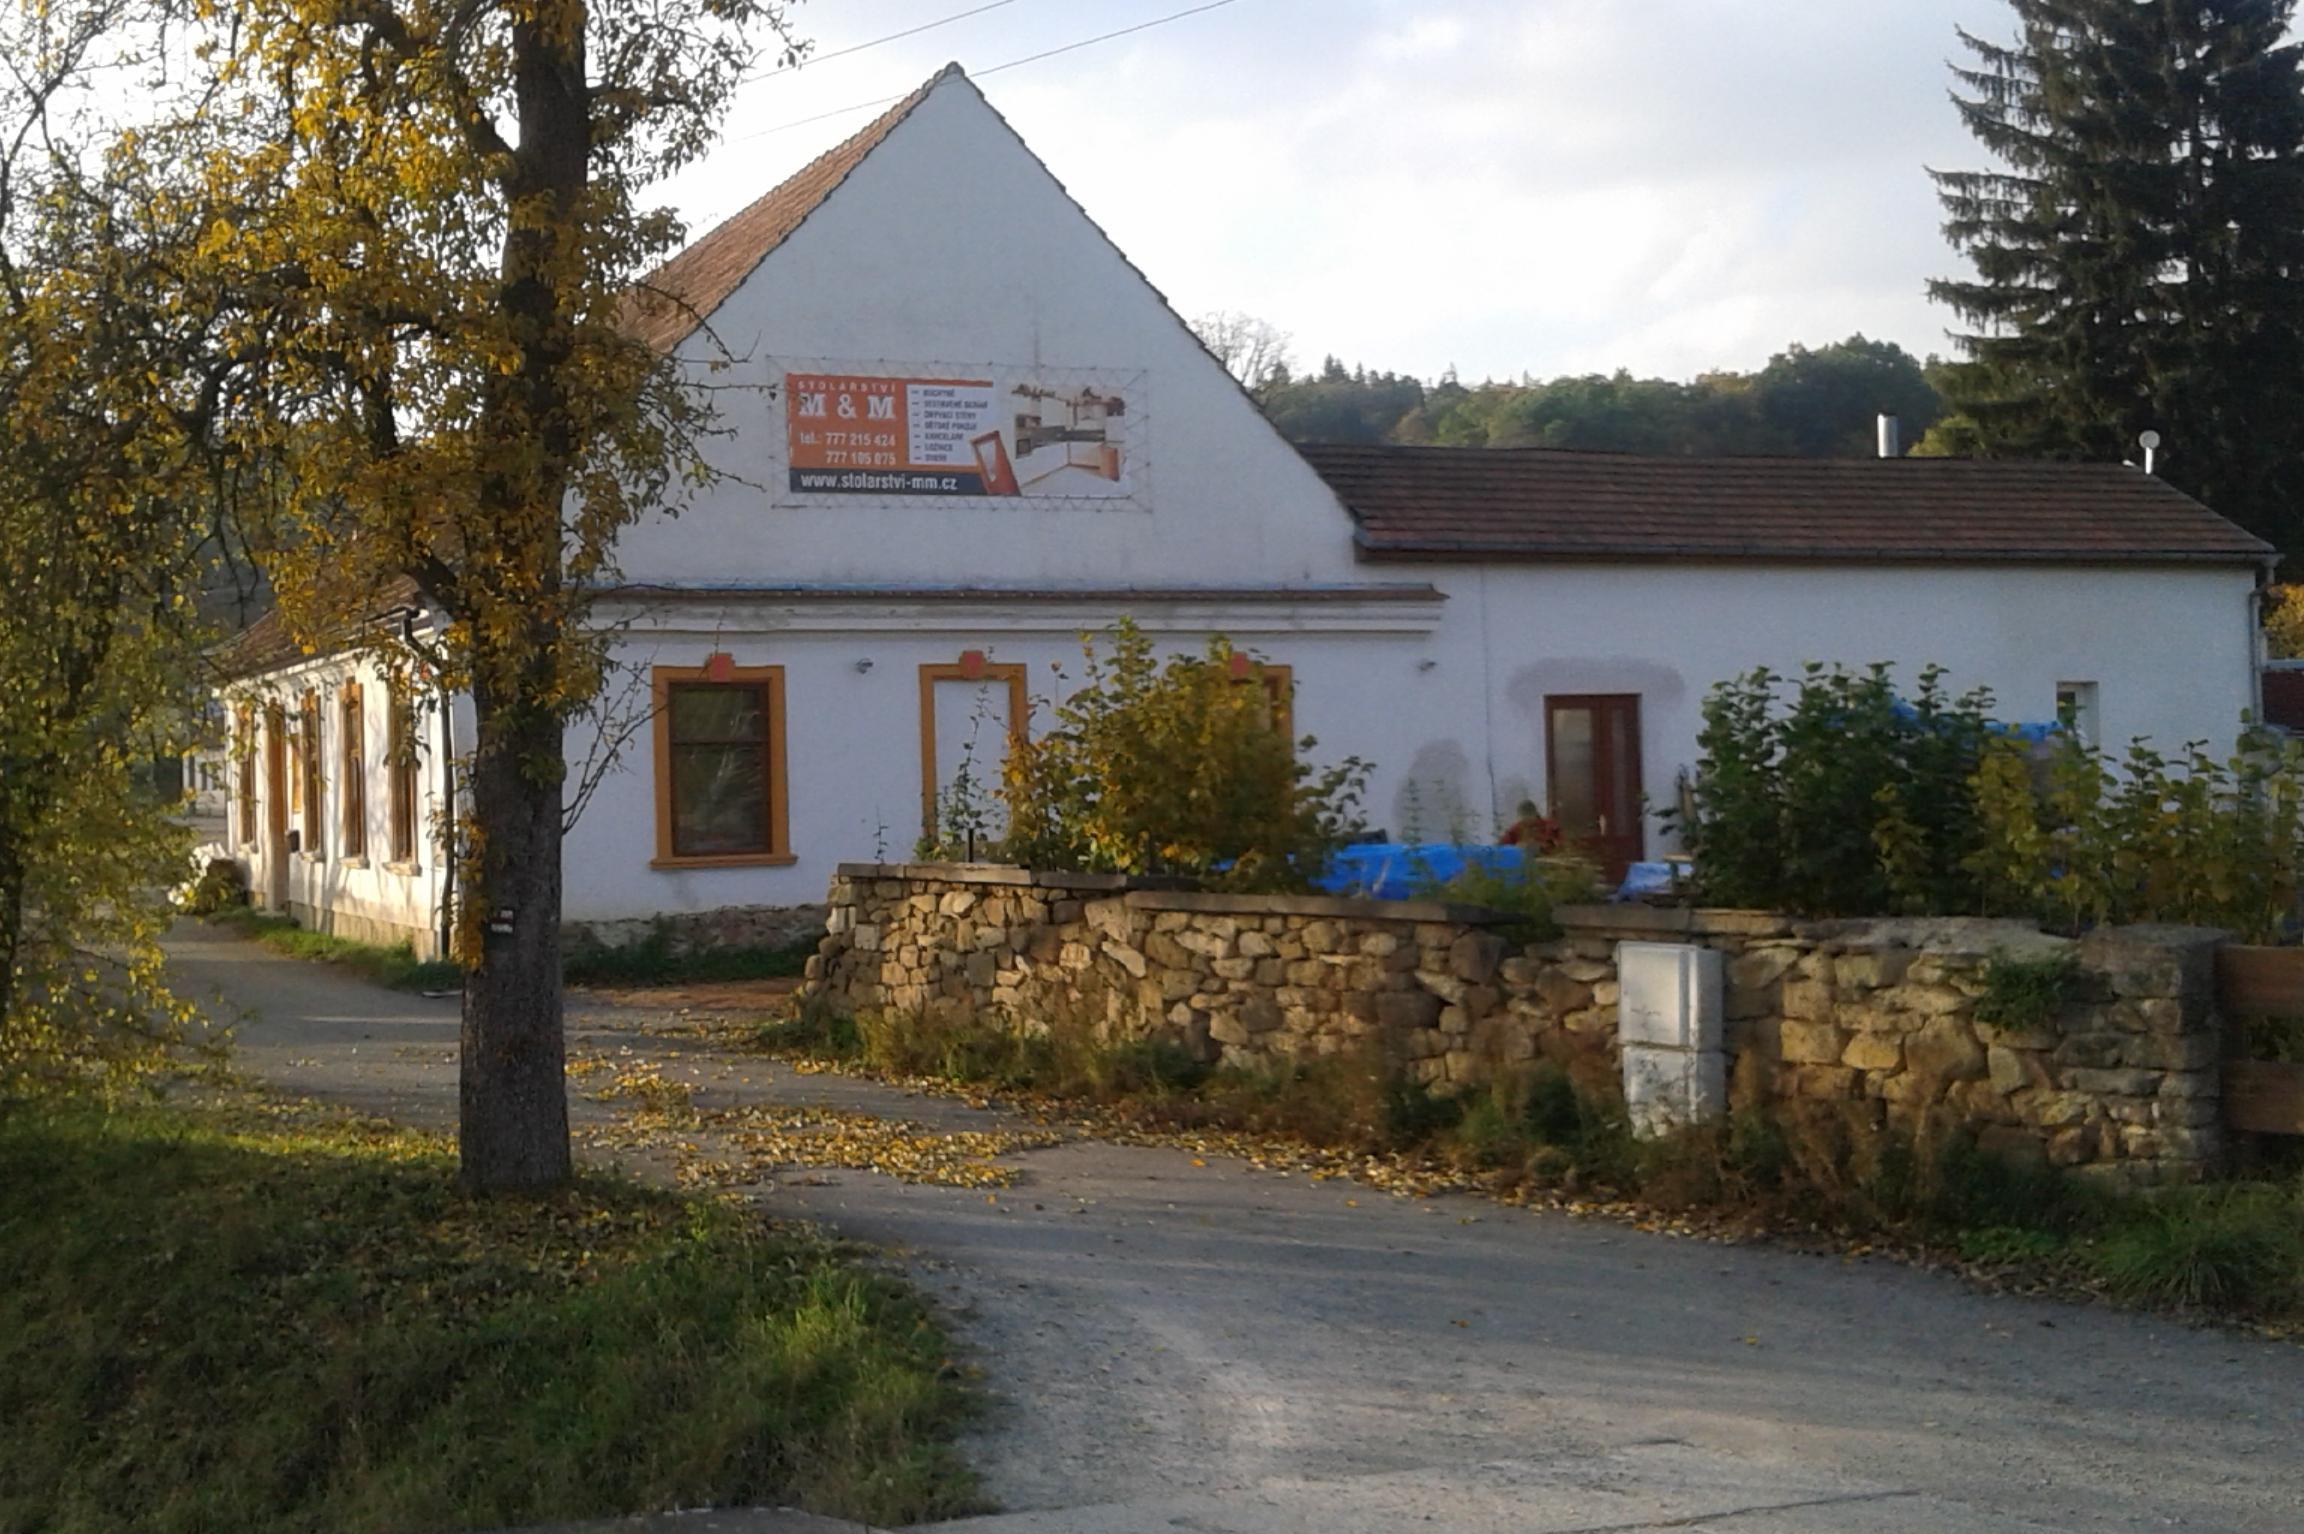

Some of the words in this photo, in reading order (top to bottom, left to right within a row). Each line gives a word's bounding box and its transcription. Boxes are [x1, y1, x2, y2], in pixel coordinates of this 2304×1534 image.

[799, 392, 826, 417] M
[837, 393, 857, 419] &
[867, 395, 896, 419] M
[825, 431, 847, 446] 777
[849, 432, 871, 446] 215
[873, 433, 896, 447] 424
[825, 450, 847, 464] 777
[874, 451, 896, 465] 075
[800, 472, 958, 490] www.stolarstvi-mm.cz
